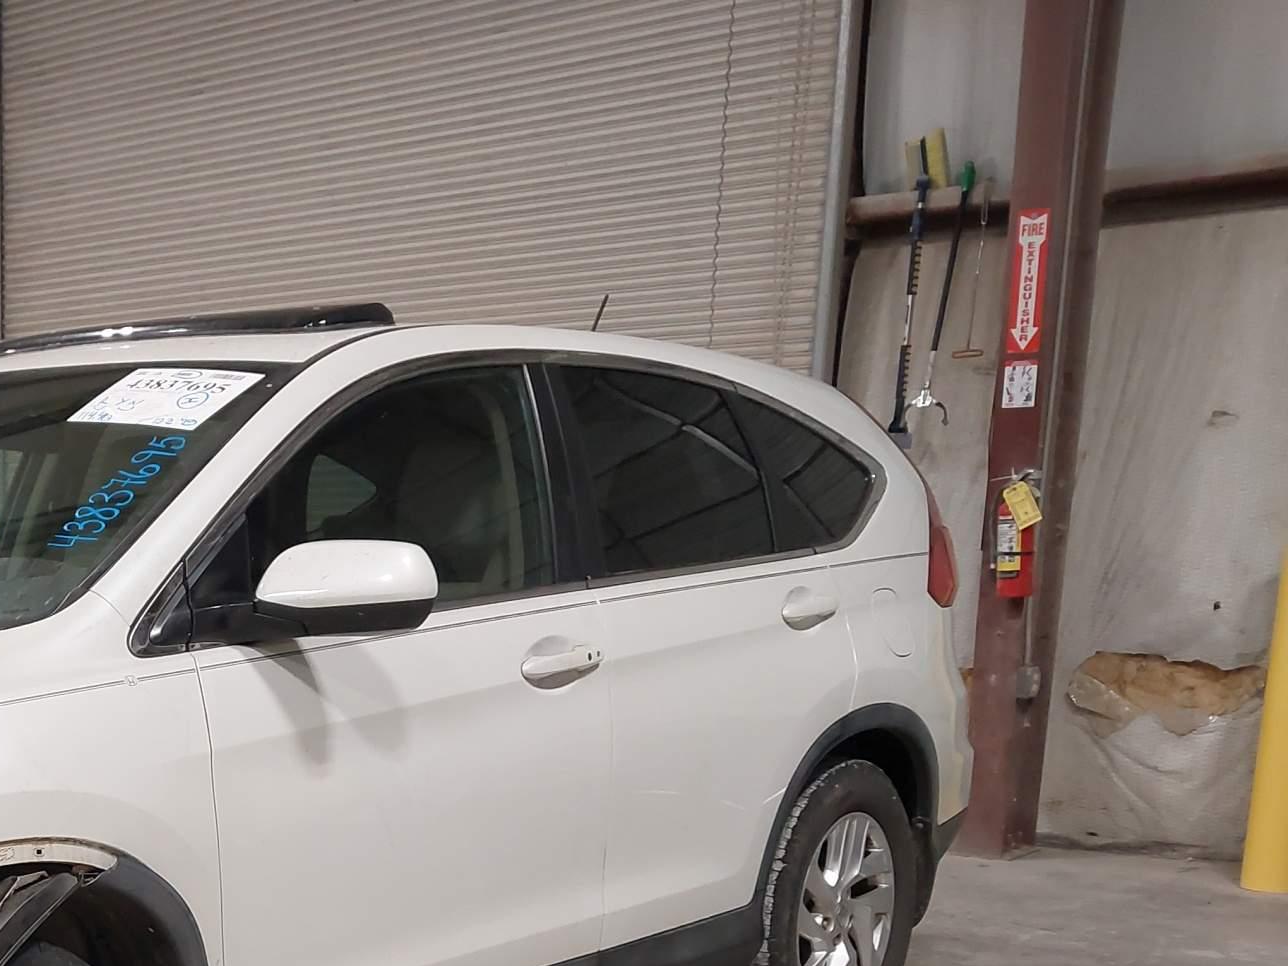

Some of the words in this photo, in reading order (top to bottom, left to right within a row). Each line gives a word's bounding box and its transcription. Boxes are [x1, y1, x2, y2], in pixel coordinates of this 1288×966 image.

[1022, 222, 1045, 237] FIRE
[1019, 241, 1037, 342] EXTINGUISHER
[127, 378, 231, 394] 43837695
[48, 434, 188, 548] 43837695
